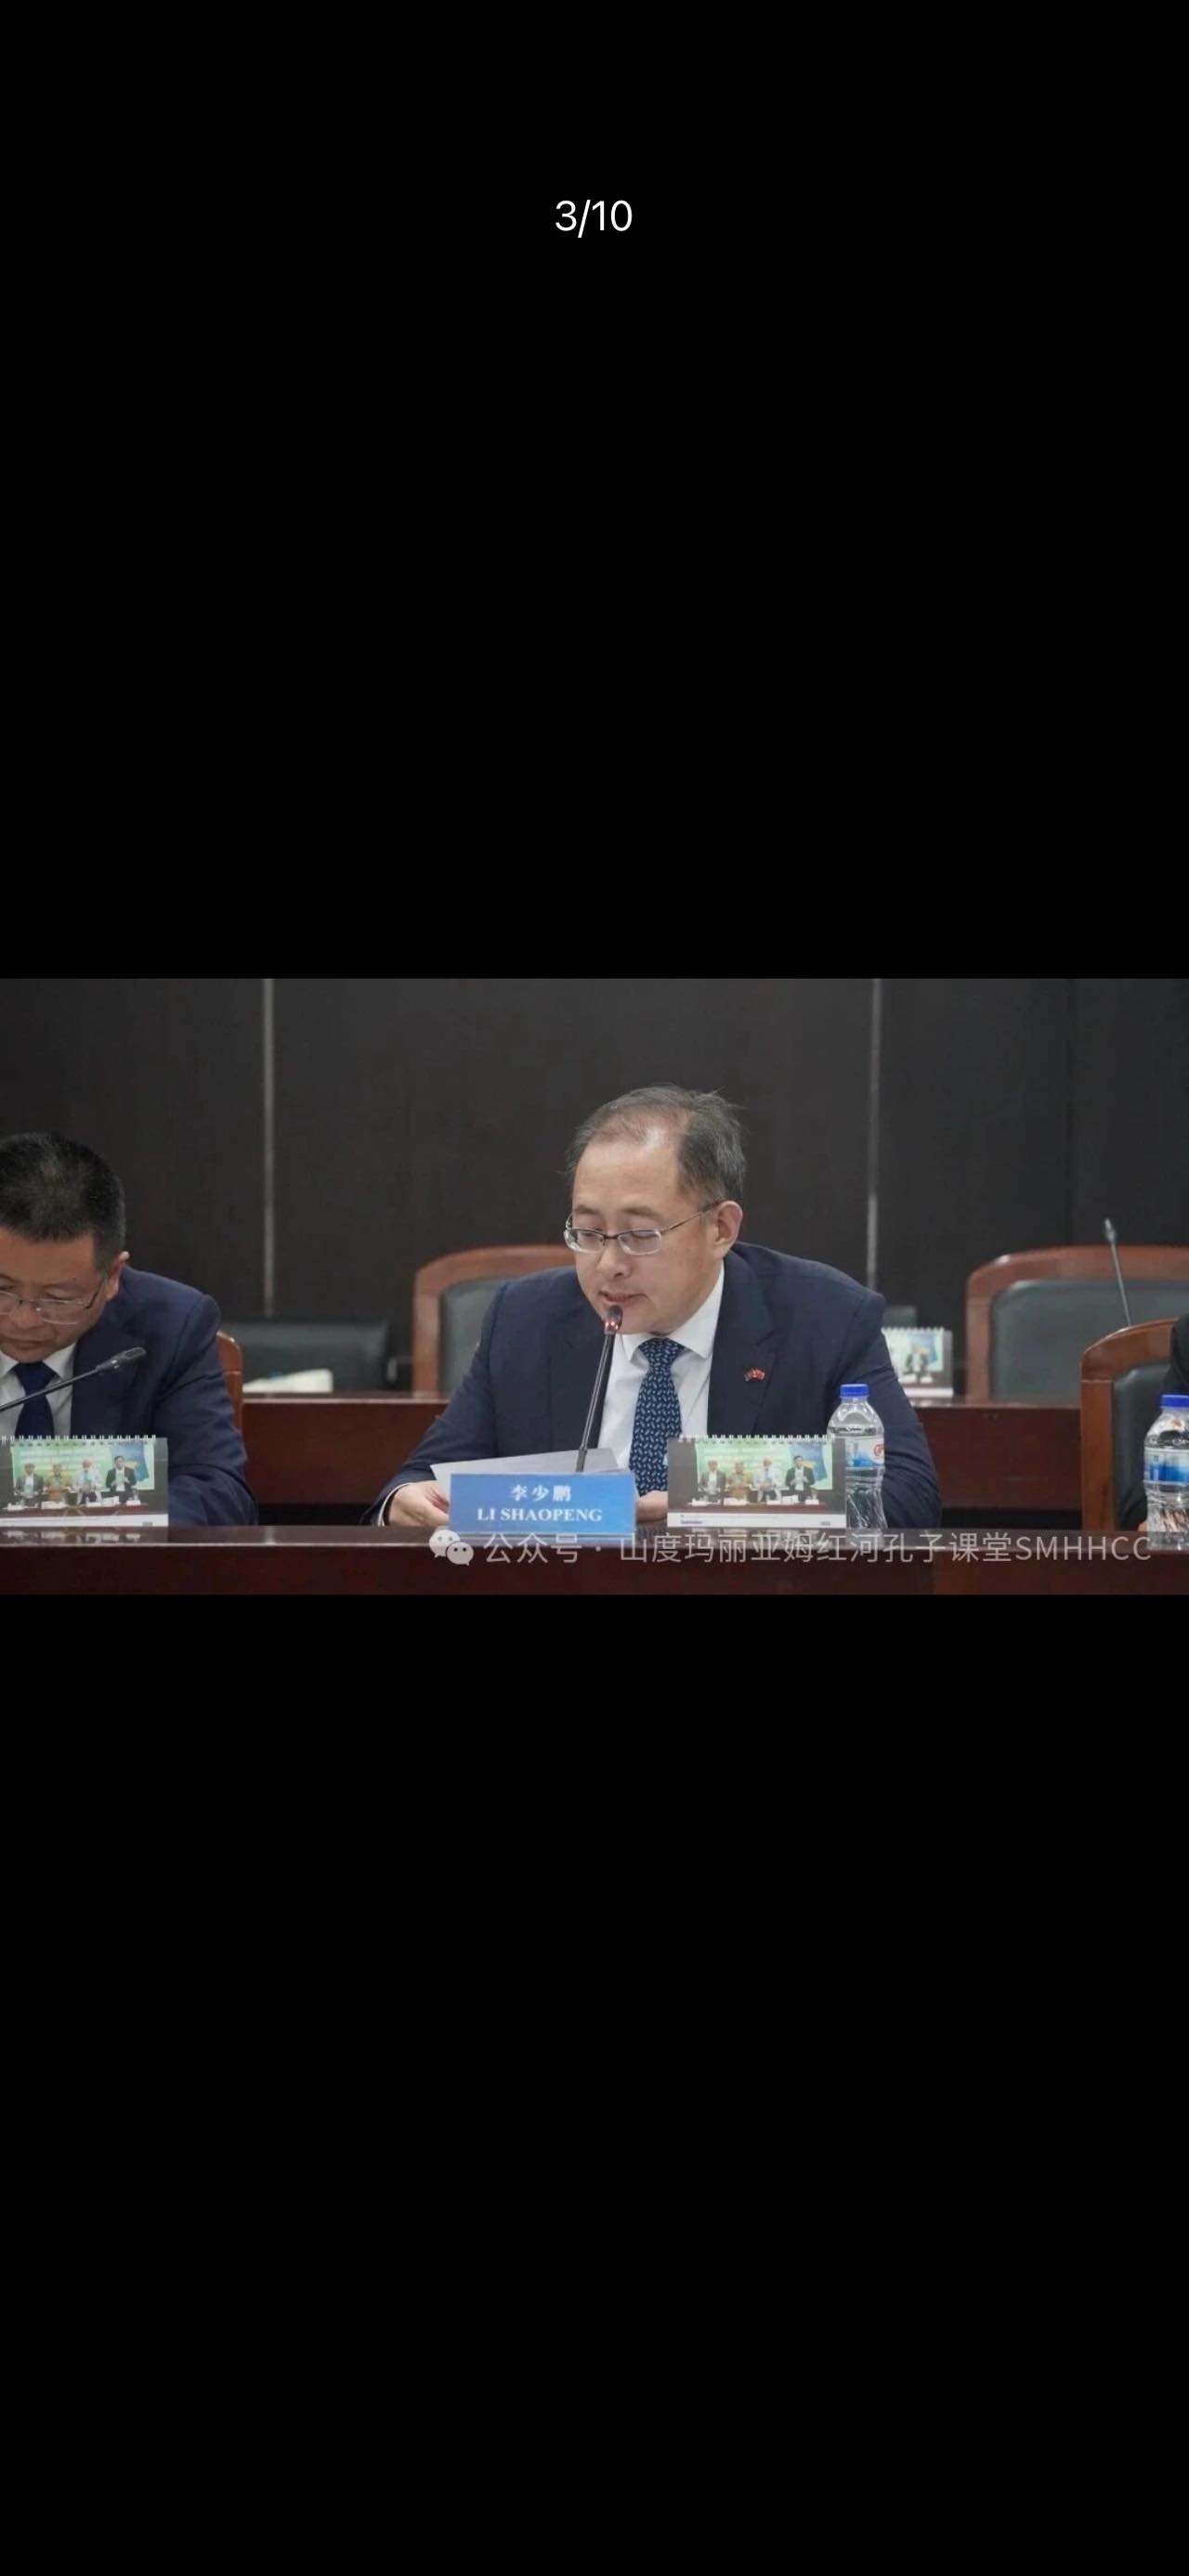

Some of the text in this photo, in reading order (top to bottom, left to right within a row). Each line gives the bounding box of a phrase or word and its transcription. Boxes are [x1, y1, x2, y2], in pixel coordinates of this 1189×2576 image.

[511, 1485, 572, 1502] 李少鹏
[477, 1507, 602, 1522] LI SHAOPENG
